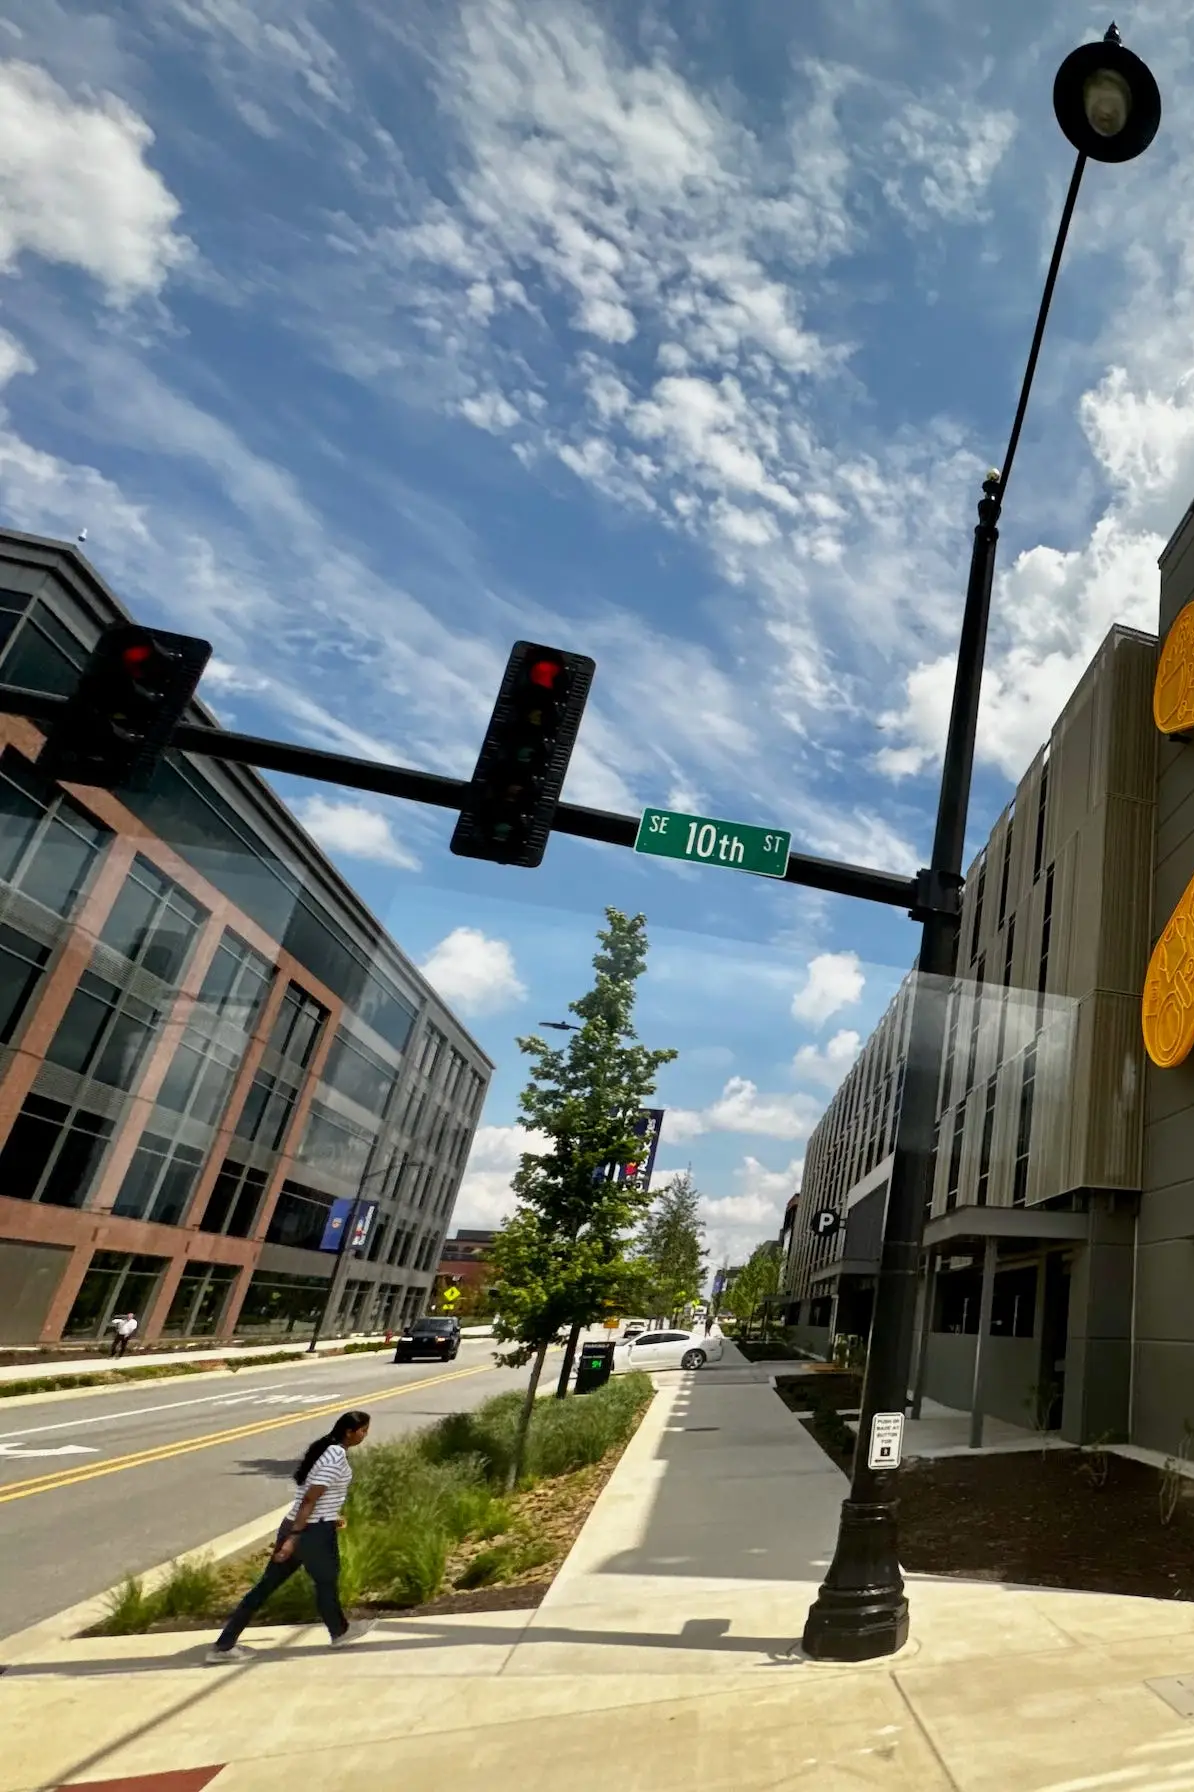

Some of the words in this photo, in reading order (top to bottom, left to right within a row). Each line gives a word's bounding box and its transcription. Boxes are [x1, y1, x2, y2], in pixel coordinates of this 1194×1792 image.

[649, 815, 670, 834] SE
[685, 822, 745, 863] 10th
[763, 834, 784, 853] ST
[818, 1212, 834, 1232] P
